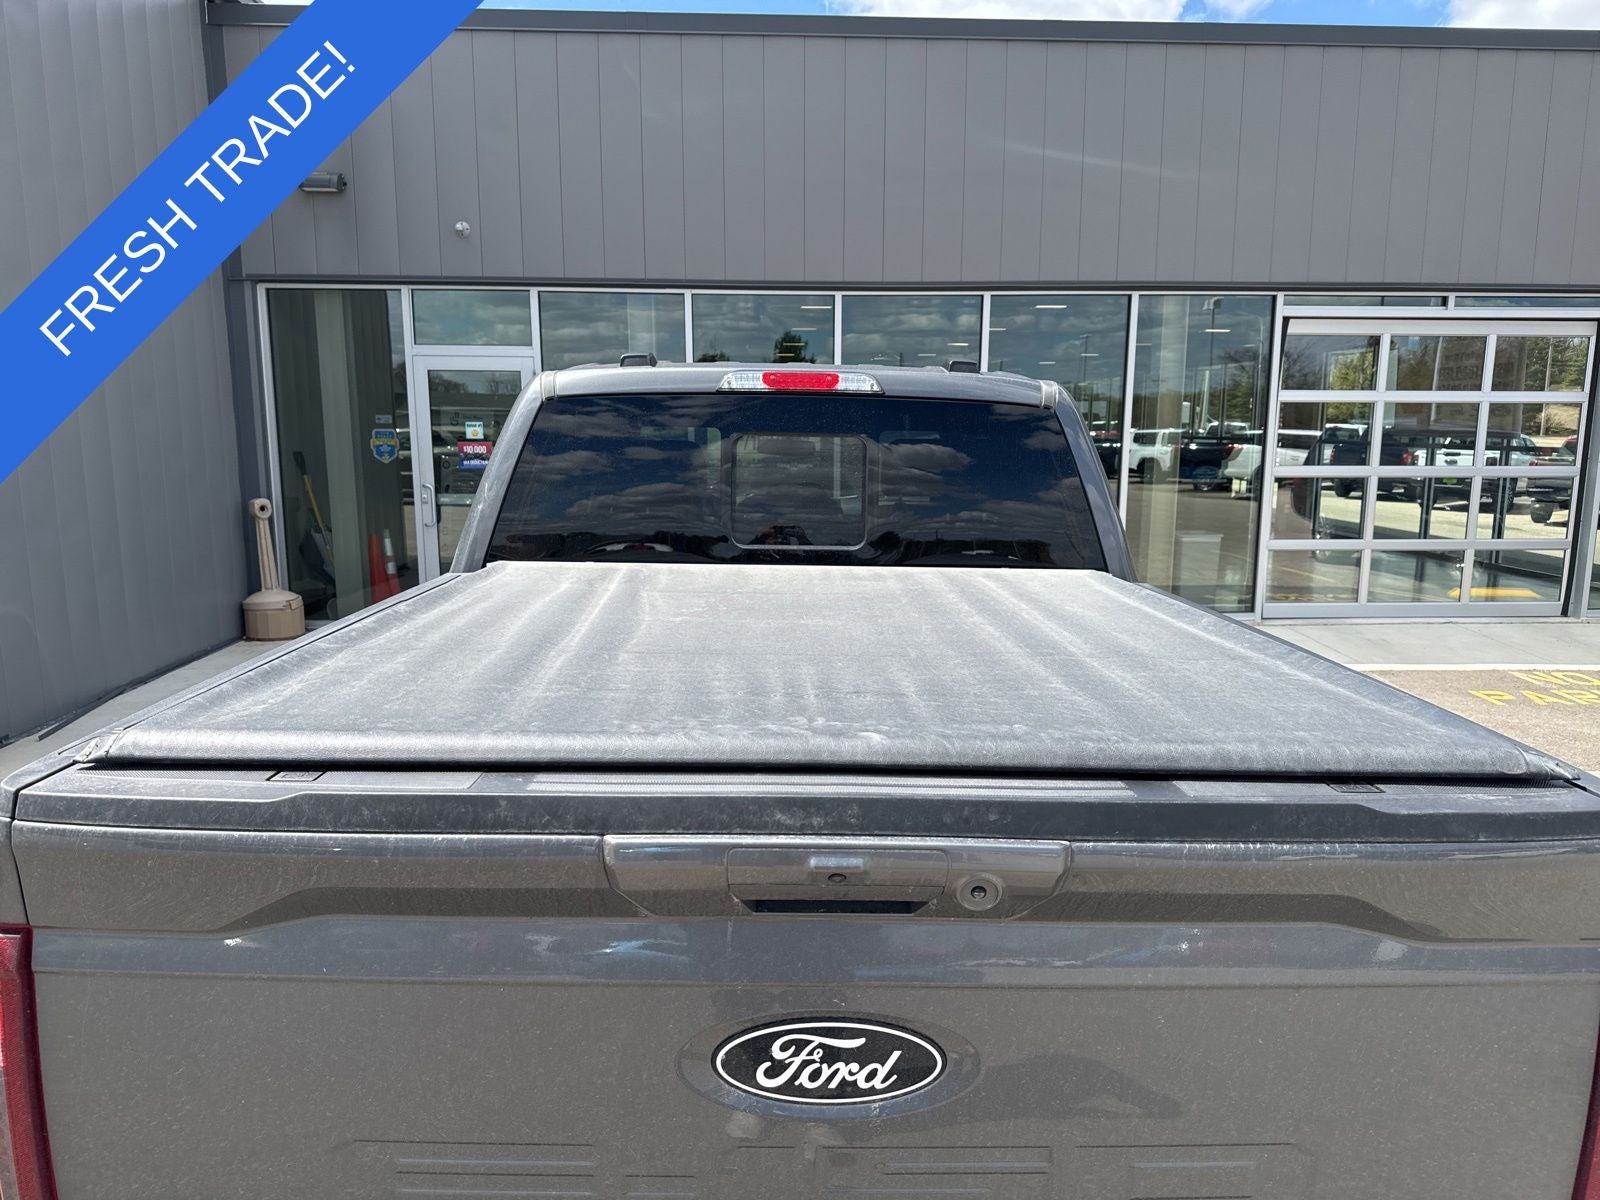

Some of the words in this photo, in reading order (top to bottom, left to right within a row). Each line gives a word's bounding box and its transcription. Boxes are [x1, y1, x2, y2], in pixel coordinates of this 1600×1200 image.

[1507, 671, 1600, 686] NO
[1467, 689, 1600, 706] PAR
[755, 1033, 902, 1089] Ford
